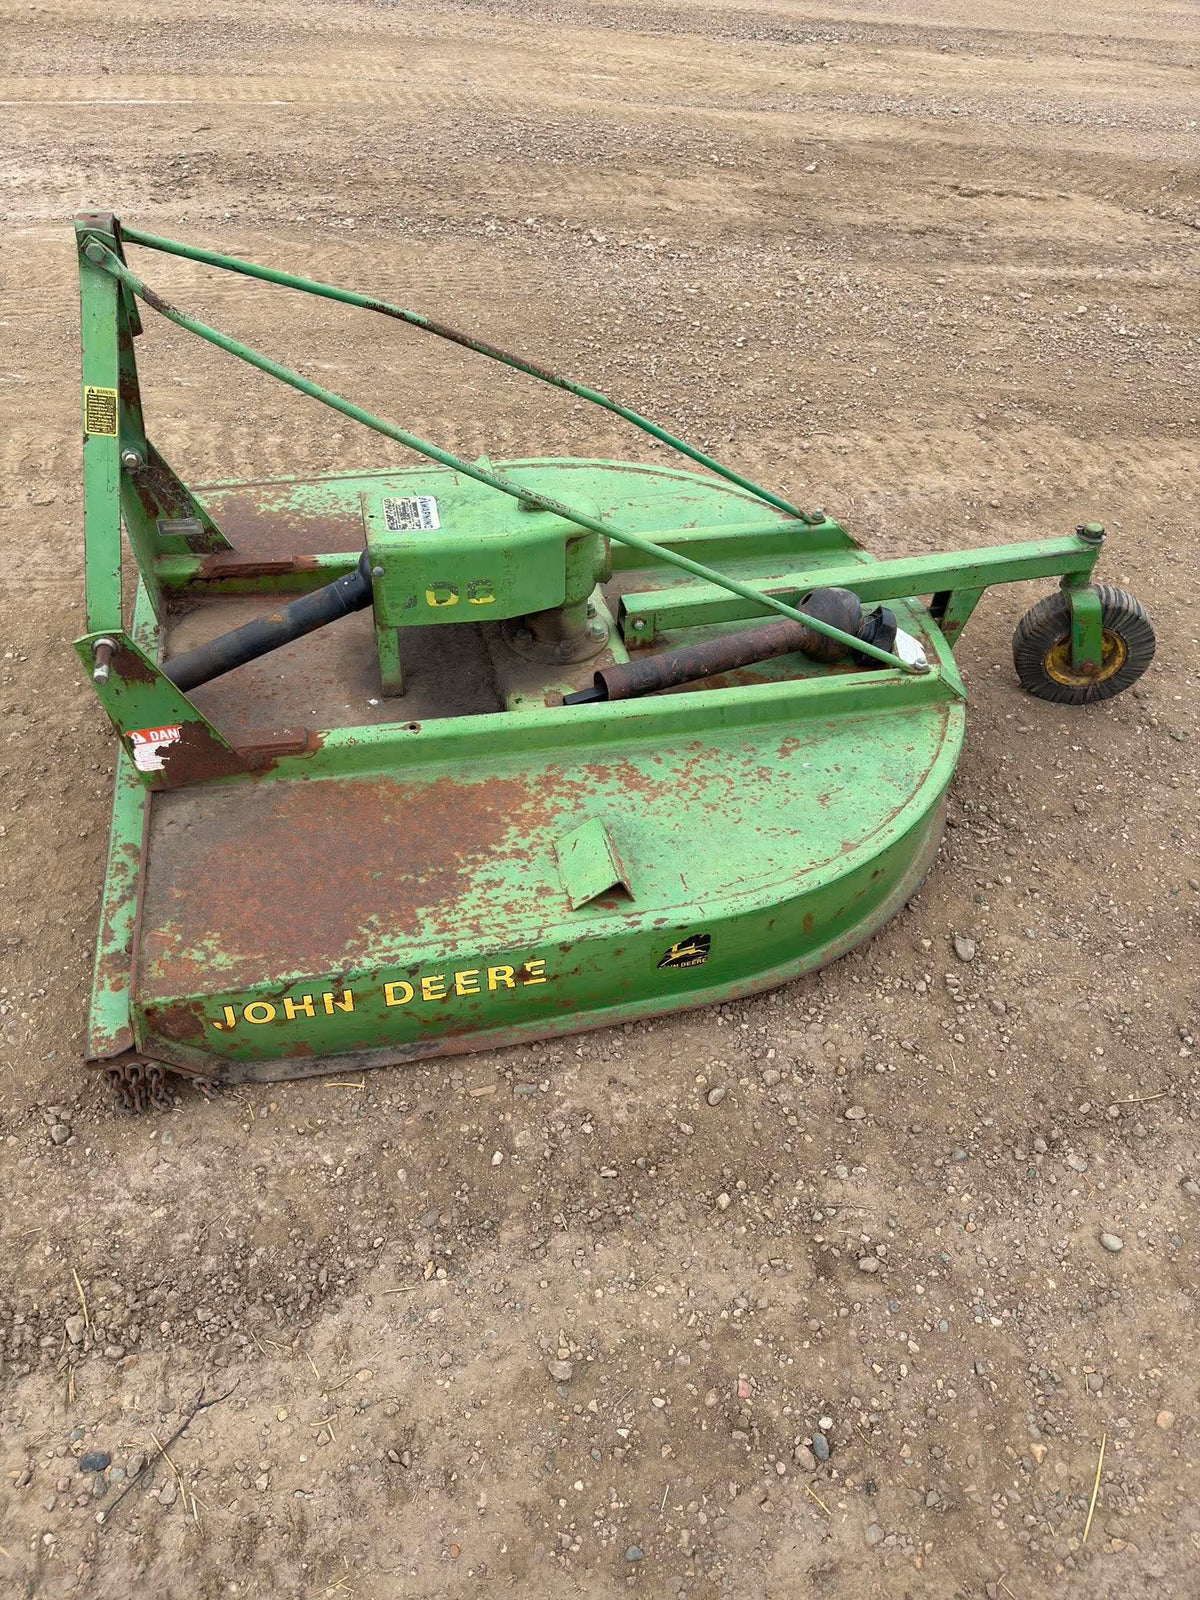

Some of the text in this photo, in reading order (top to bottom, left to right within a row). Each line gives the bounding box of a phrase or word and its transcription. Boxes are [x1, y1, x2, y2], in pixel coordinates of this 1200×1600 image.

[680, 957, 708, 968] DEERE
[211, 959, 547, 1031] JOHN DEERE
